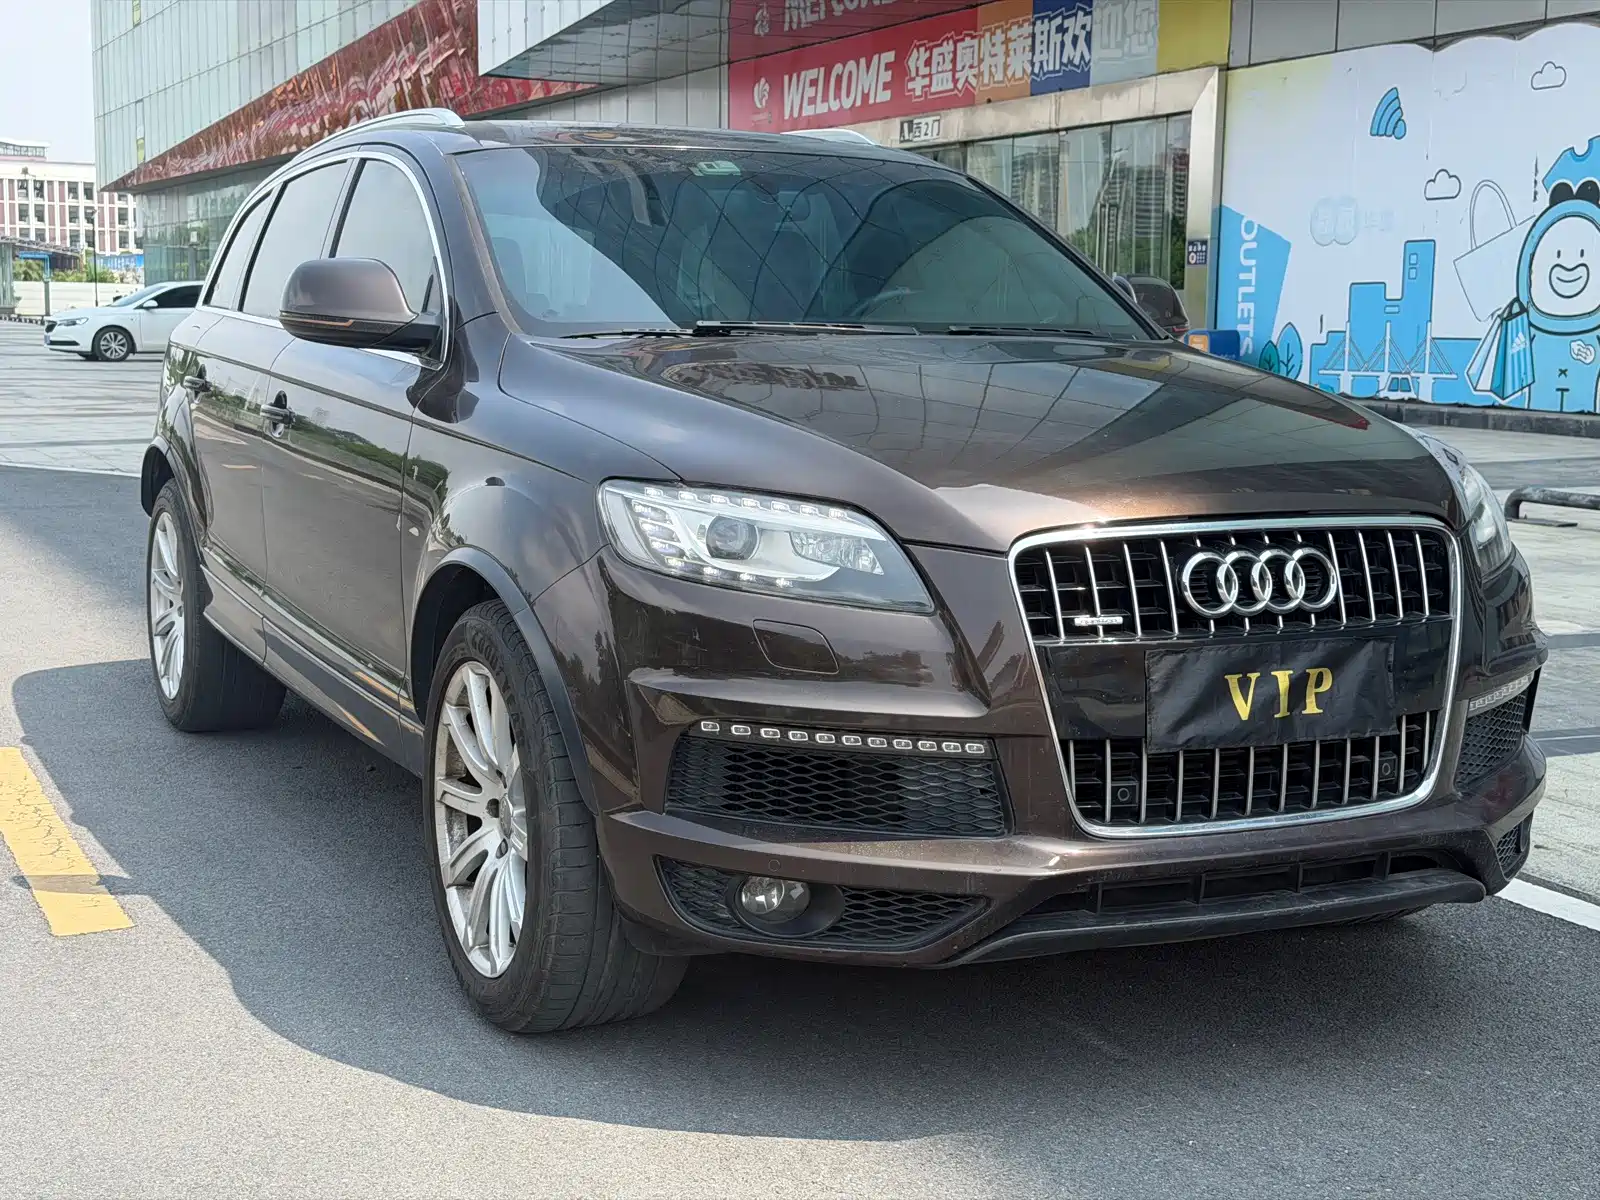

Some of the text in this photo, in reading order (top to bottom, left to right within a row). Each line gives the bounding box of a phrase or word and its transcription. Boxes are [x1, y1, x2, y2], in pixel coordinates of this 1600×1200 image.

[784, 50, 896, 120] WELCOME
[1236, 217, 1258, 357] OUTLETS
[1225, 668, 1332, 720] VIP
